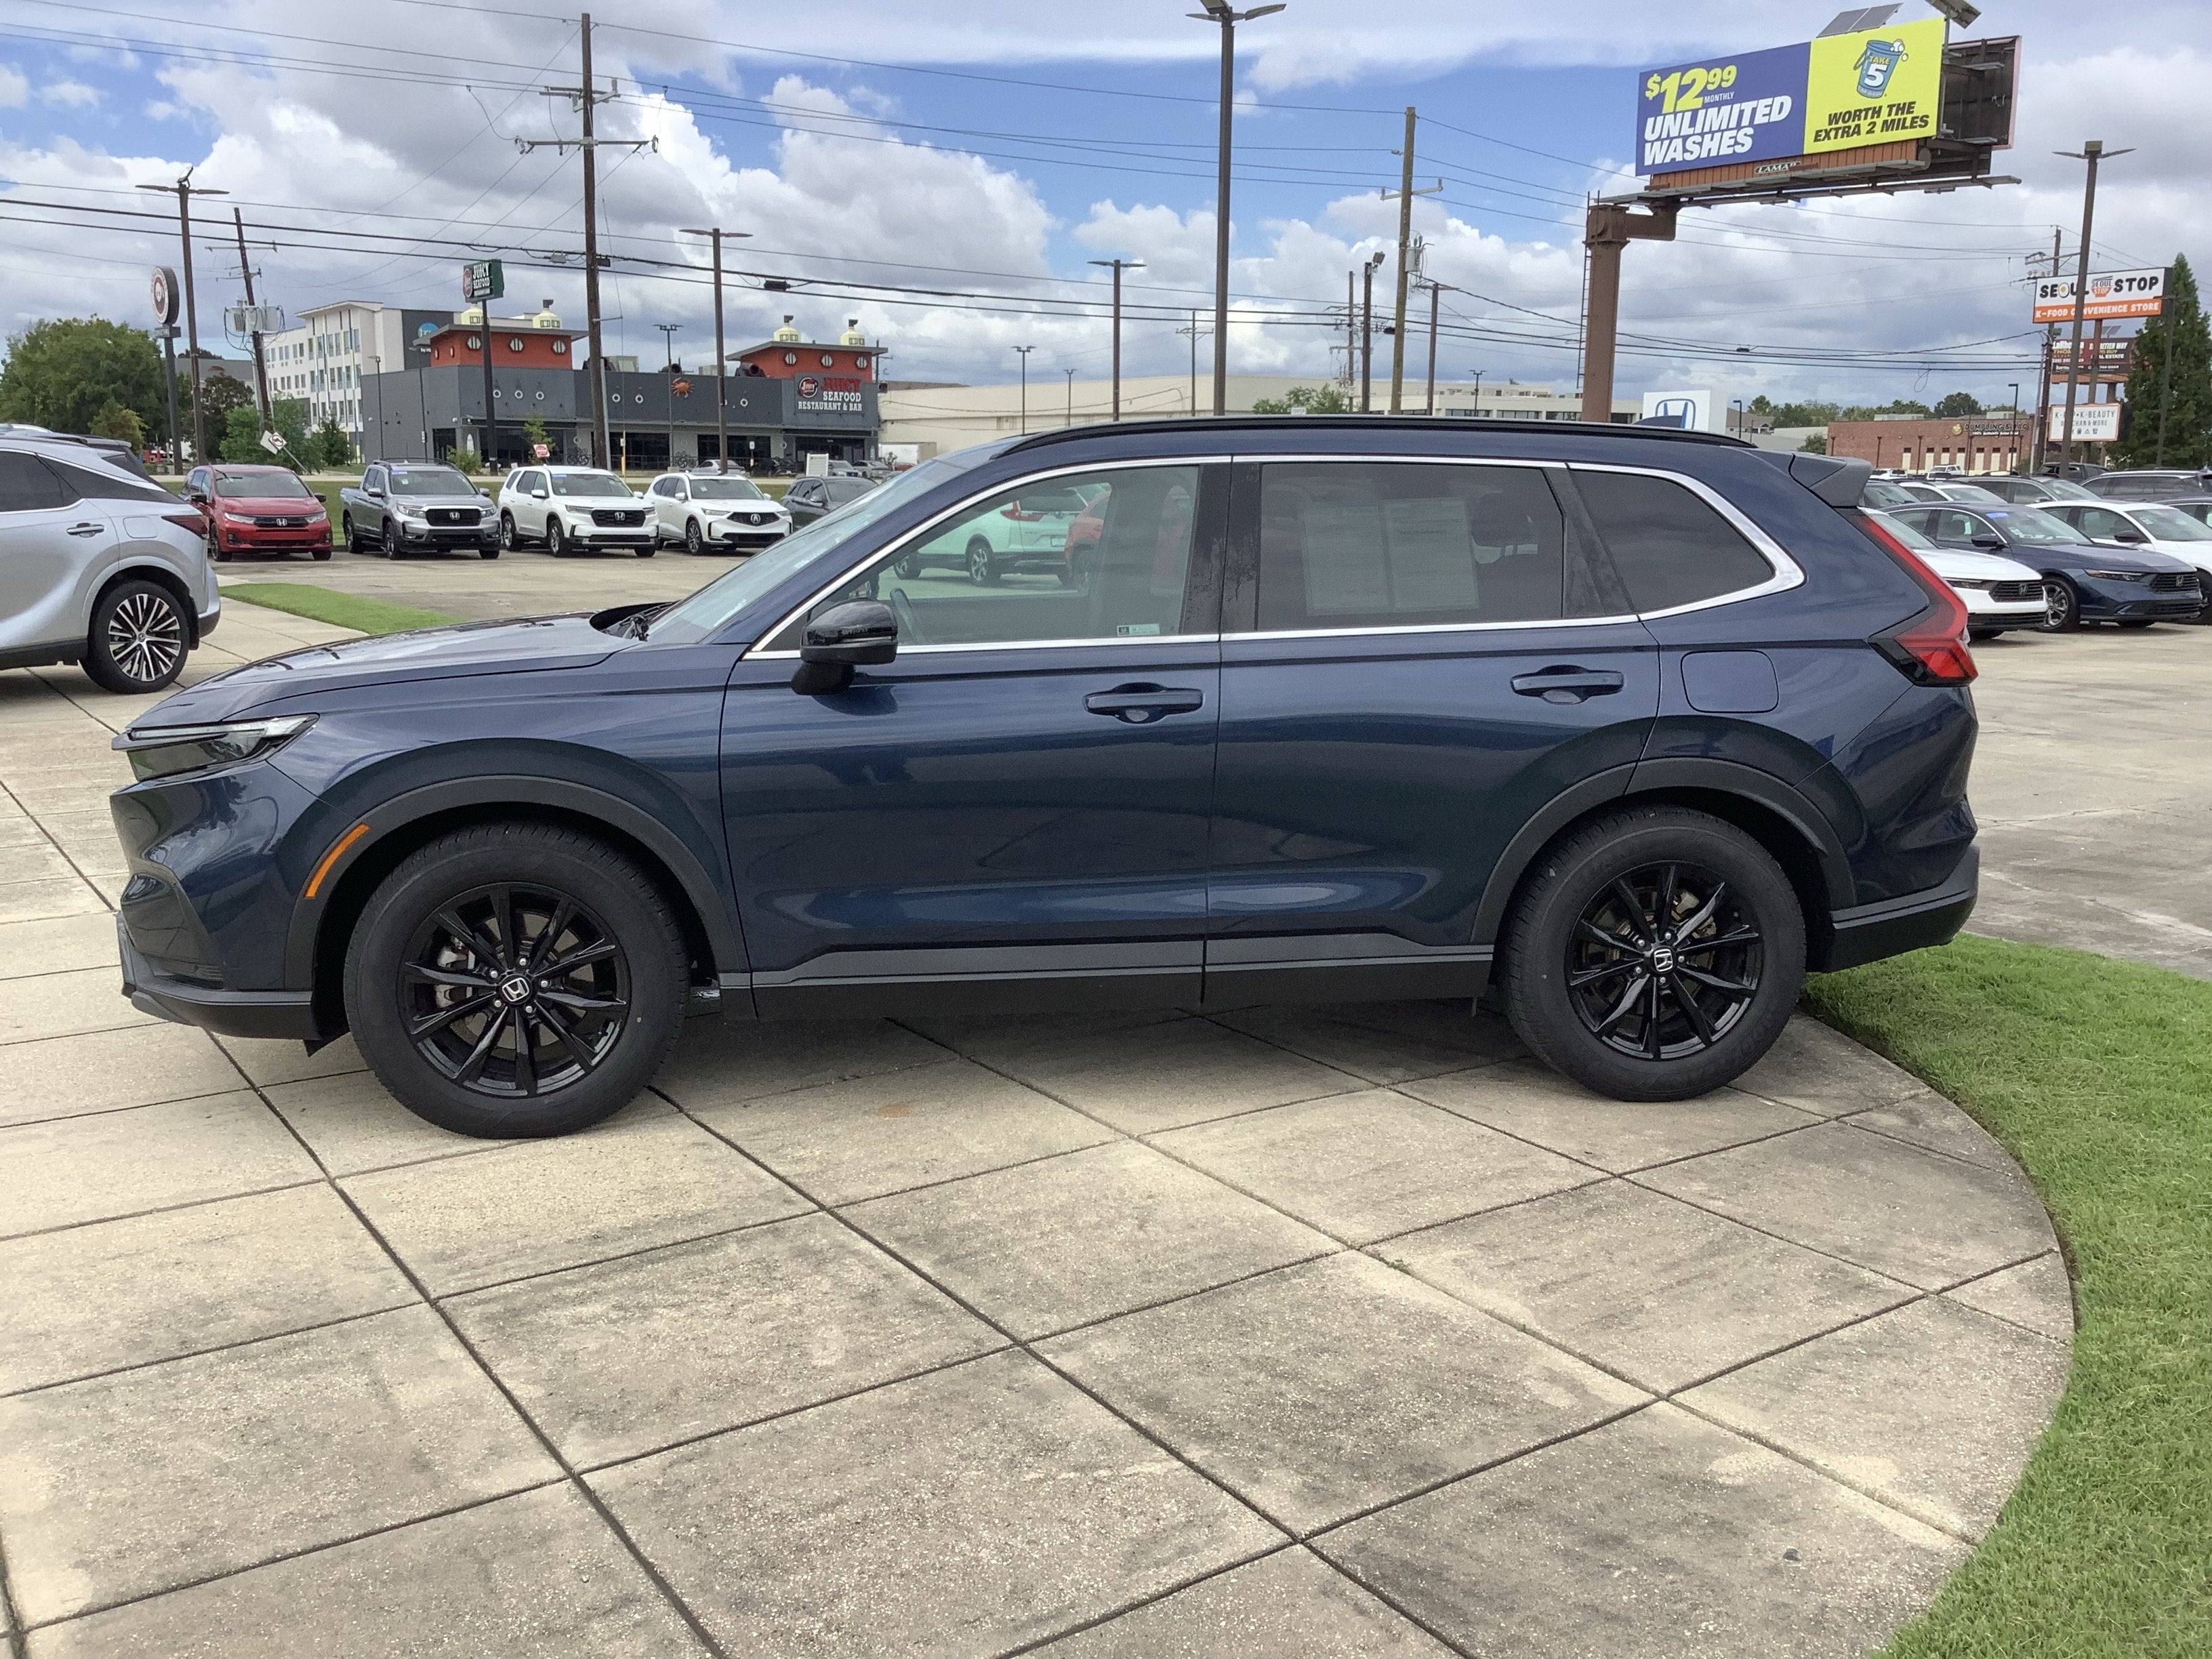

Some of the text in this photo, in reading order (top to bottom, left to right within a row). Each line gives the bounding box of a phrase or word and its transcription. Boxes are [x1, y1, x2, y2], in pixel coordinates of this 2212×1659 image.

[1870, 56, 1891, 64] TAKE
[1864, 63, 1887, 87] 5
[1704, 91, 1734, 104] MONTHLY
[1645, 95, 1793, 141] UNLIMITED
[1828, 101, 1916, 126] WORTH THE
[1814, 115, 1930, 142] EXTRA 2 MILES
[1644, 127, 1755, 166] WASHES
[473, 262, 489, 279] JUICY
[2039, 276, 2159, 298] SEOU STOP
[2035, 302, 2159, 318] K-FOOD CNVENIENCE STORE
[821, 377, 861, 391] JUICY
[823, 391, 861, 402] SEAFOOD
[798, 401, 862, 411] RESTAURANT & BAR
[1965, 423, 2004, 431] DUMPLING
